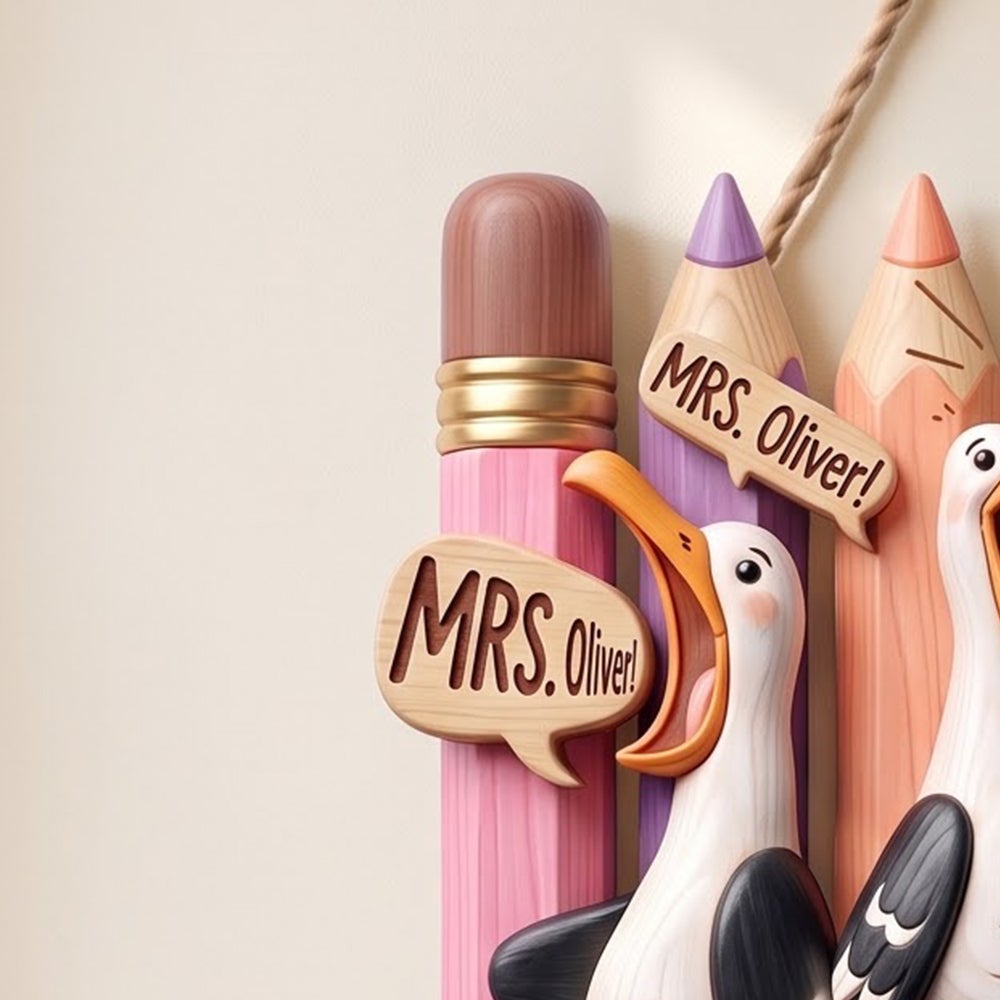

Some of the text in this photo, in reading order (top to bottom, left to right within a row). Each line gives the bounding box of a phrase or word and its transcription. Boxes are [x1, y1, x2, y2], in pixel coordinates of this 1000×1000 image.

[649, 342, 885, 508] MRS. Oliver!
[388, 555, 638, 697] MRS. Oliver!
